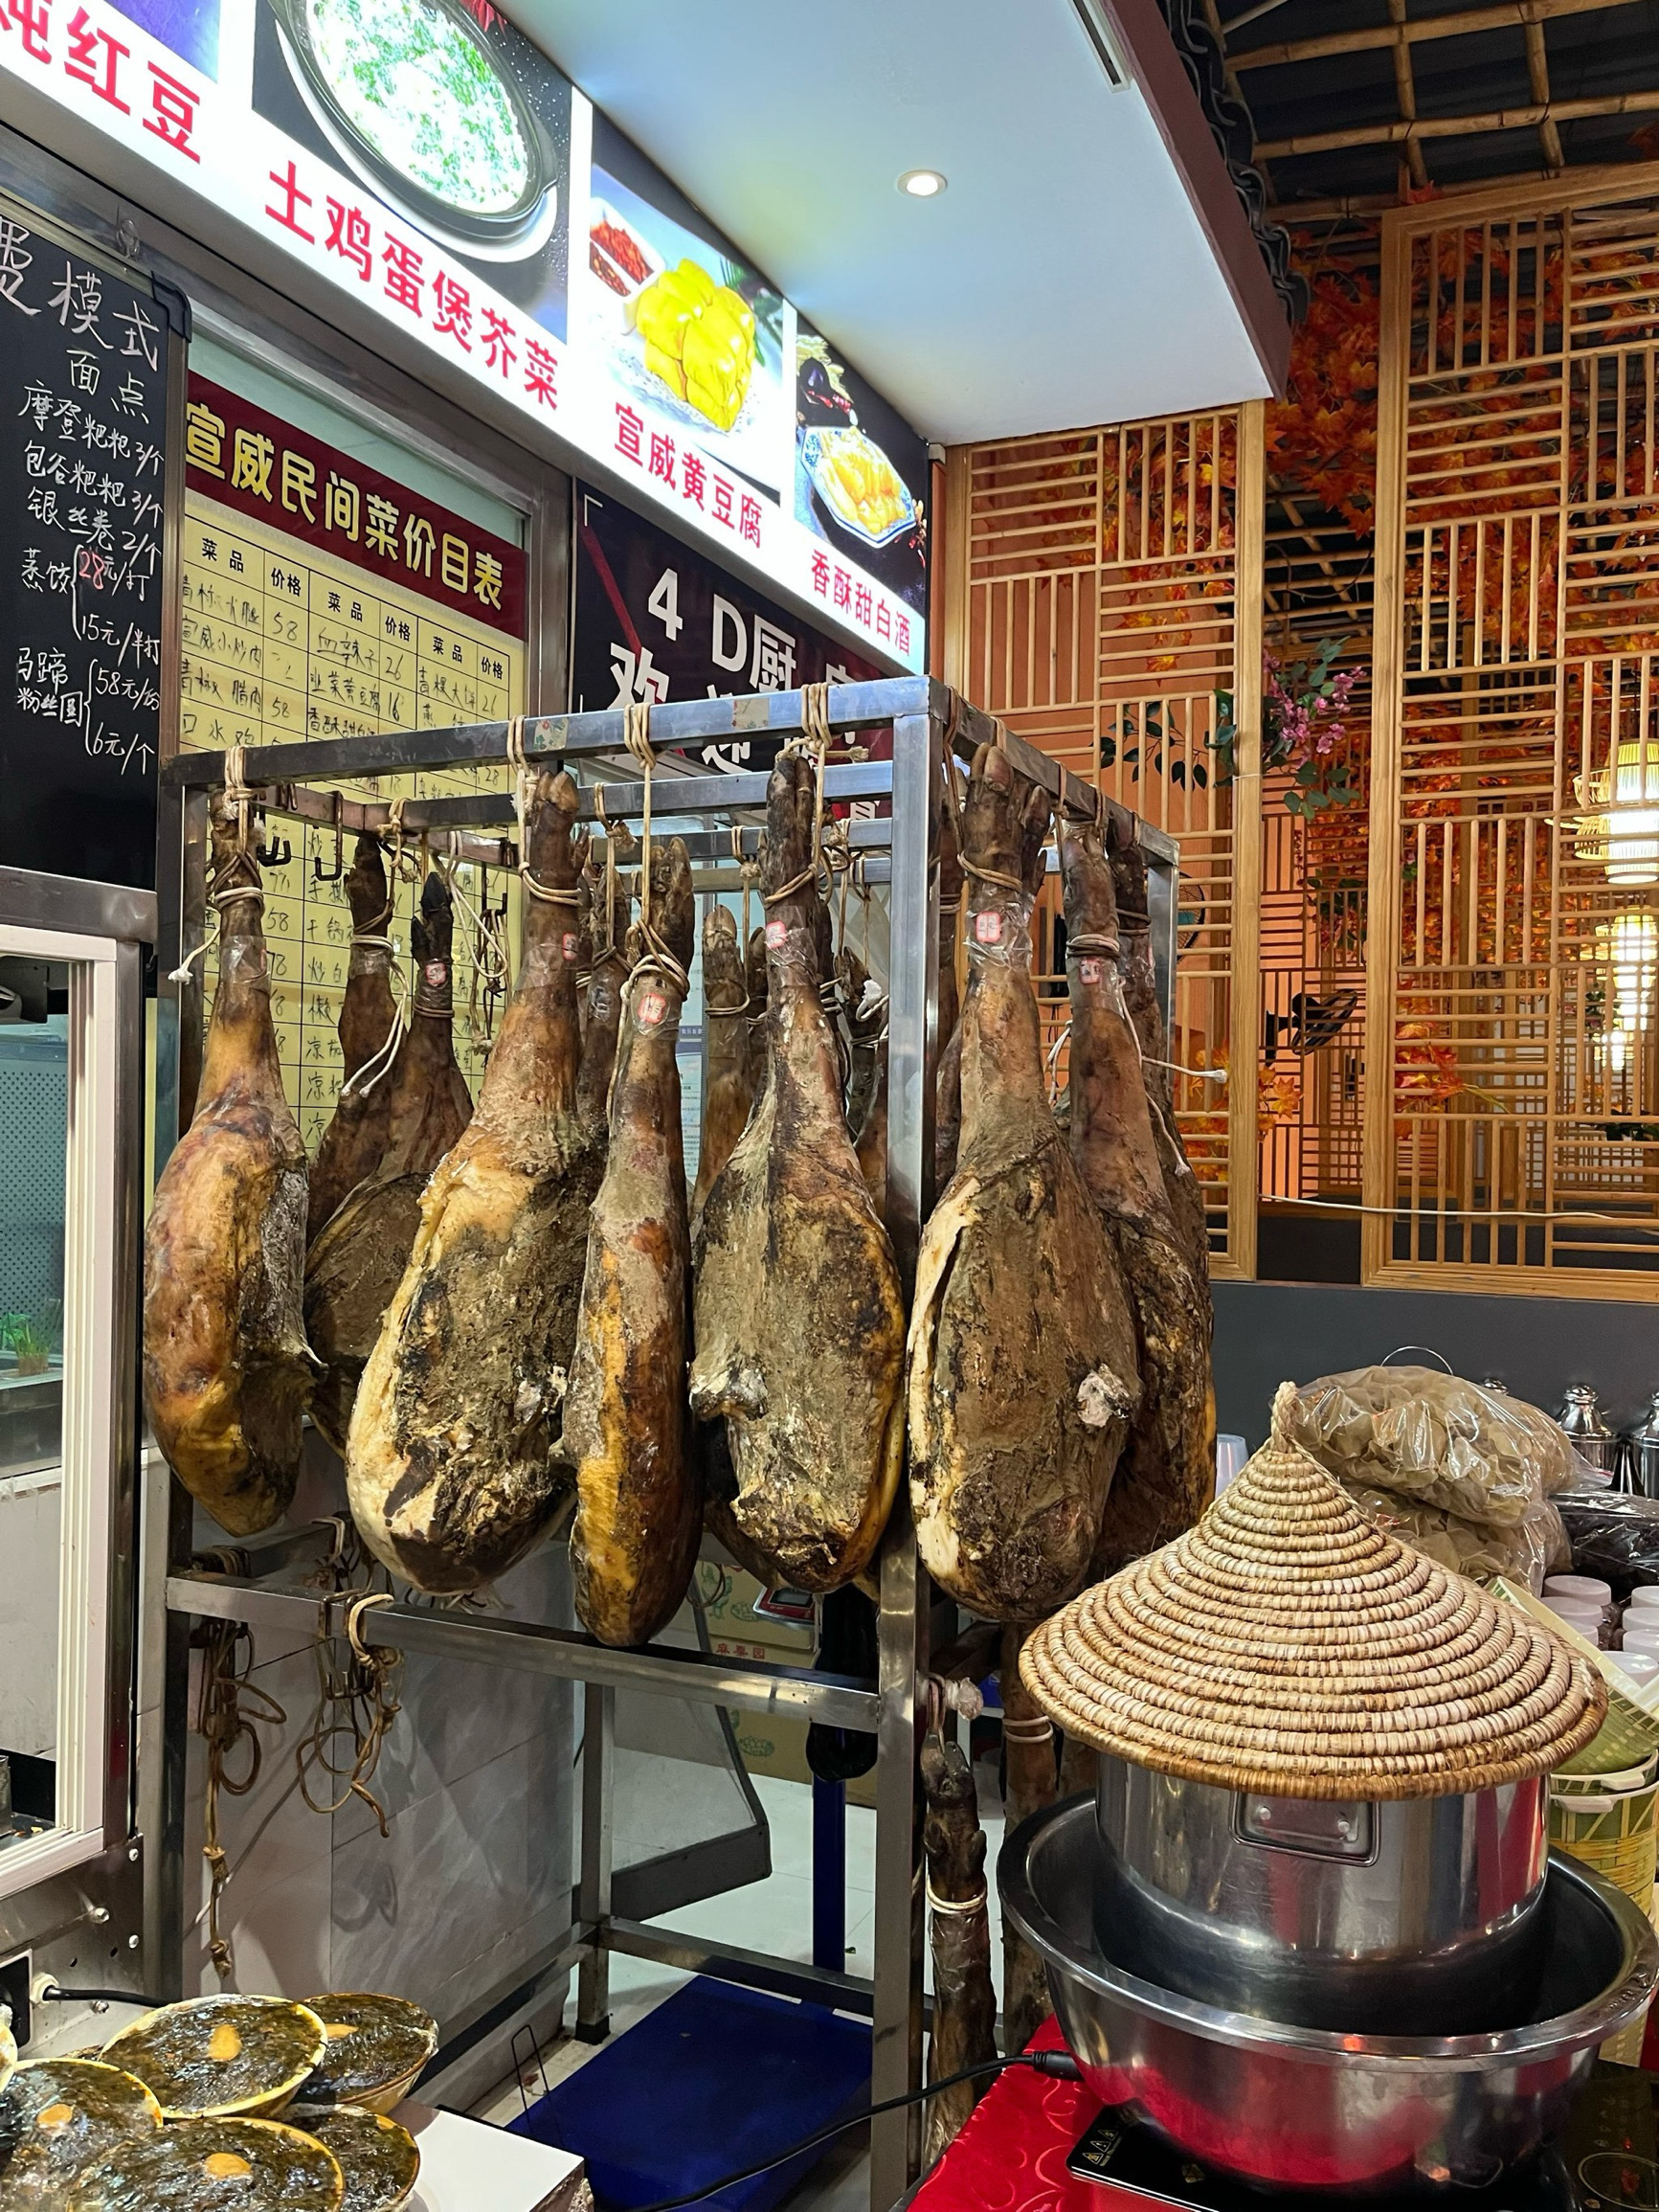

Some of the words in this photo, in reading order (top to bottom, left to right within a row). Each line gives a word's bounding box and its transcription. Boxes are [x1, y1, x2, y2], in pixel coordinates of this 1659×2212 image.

[265, 161, 558, 411] 土鸡蛋煲芥菜
[186, 402, 504, 611] 宣威民间菜价目表
[615, 401, 762, 549] 宣威黄豆腐
[201, 537, 244, 574] 菜品
[271, 567, 302, 597] 价格
[327, 592, 363, 622] 菜品
[385, 616, 412, 643] 价格
[433, 636, 463, 664] 菜品
[481, 656, 504, 681] 价格
[272, 611, 299, 642] 58
[385, 654, 404, 682] 26
[812, 550, 910, 657] 香酥甜白酒
[266, 907, 289, 932] 58
